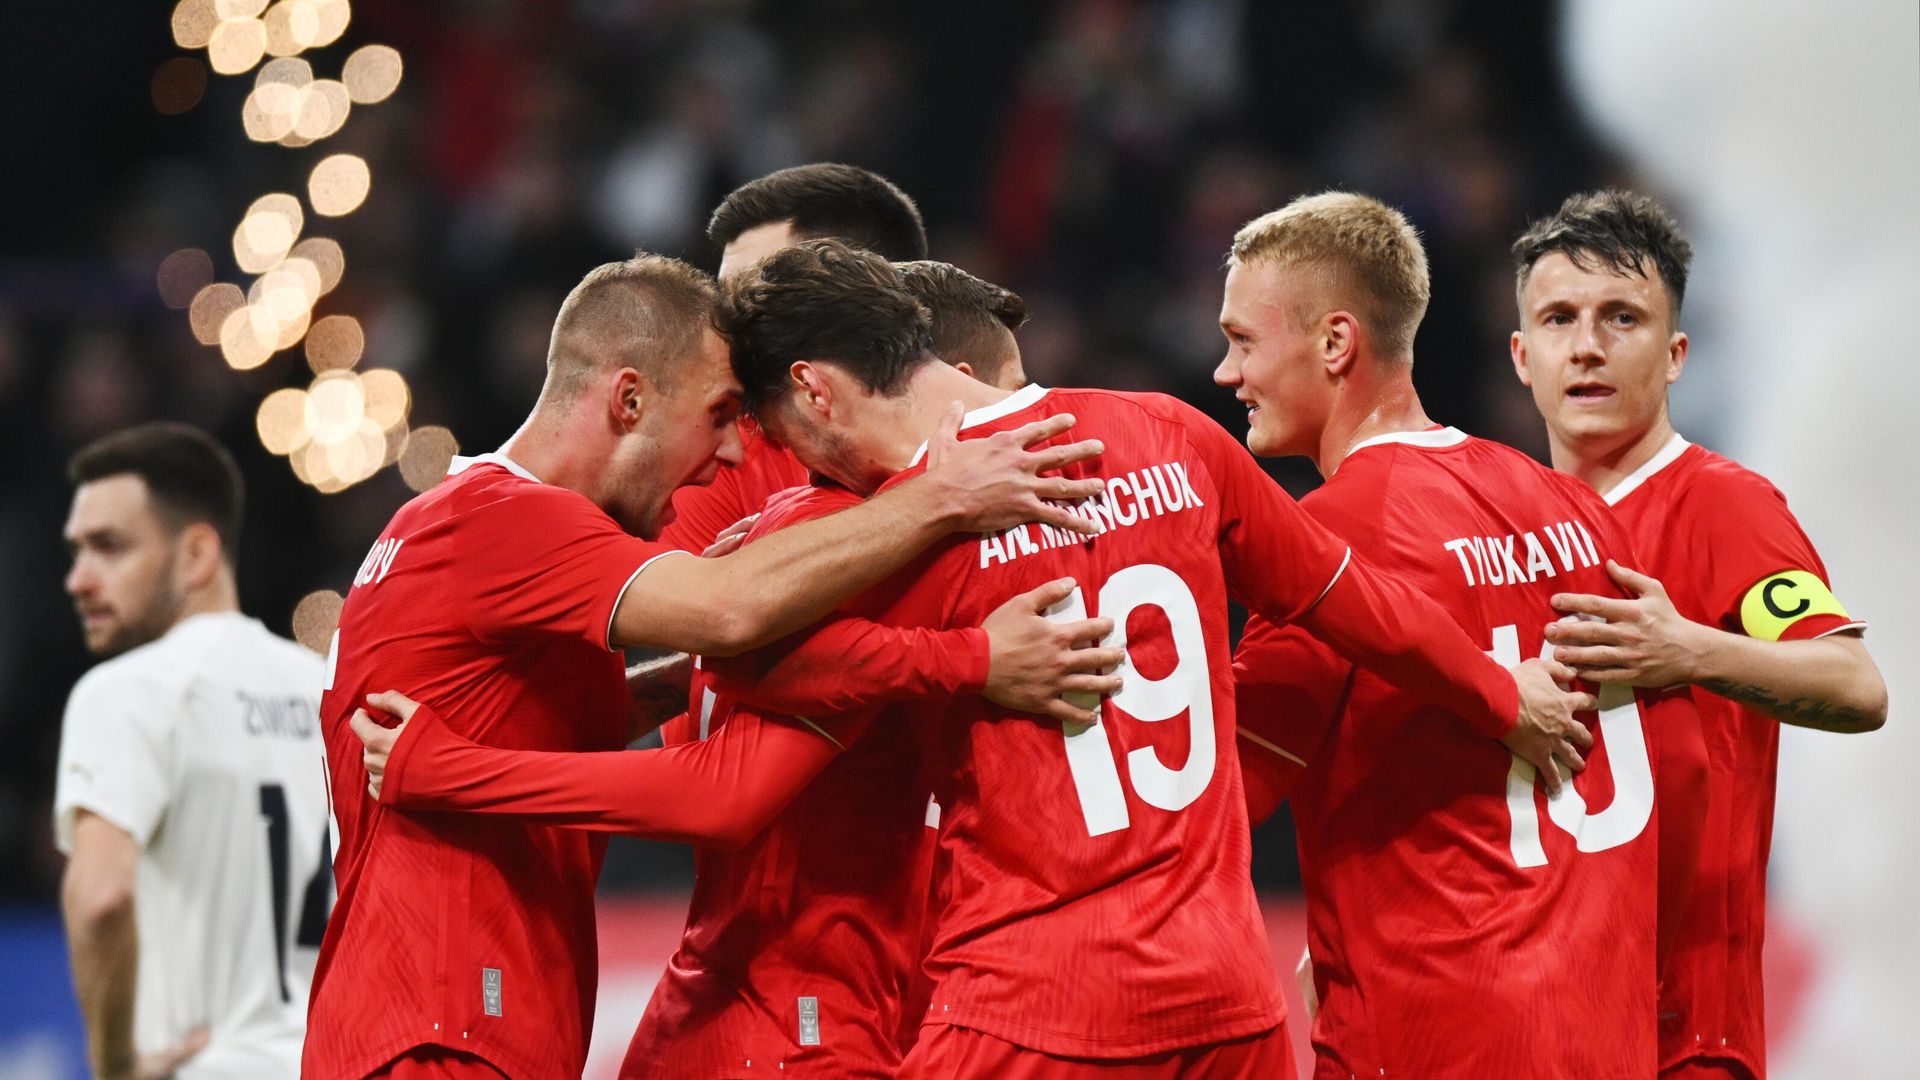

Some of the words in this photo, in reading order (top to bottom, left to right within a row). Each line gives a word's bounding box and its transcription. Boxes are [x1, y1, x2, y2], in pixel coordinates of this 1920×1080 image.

[1043, 564, 1216, 837] 19
[1763, 578, 1810, 618] C
[1484, 614, 1655, 868] 10
